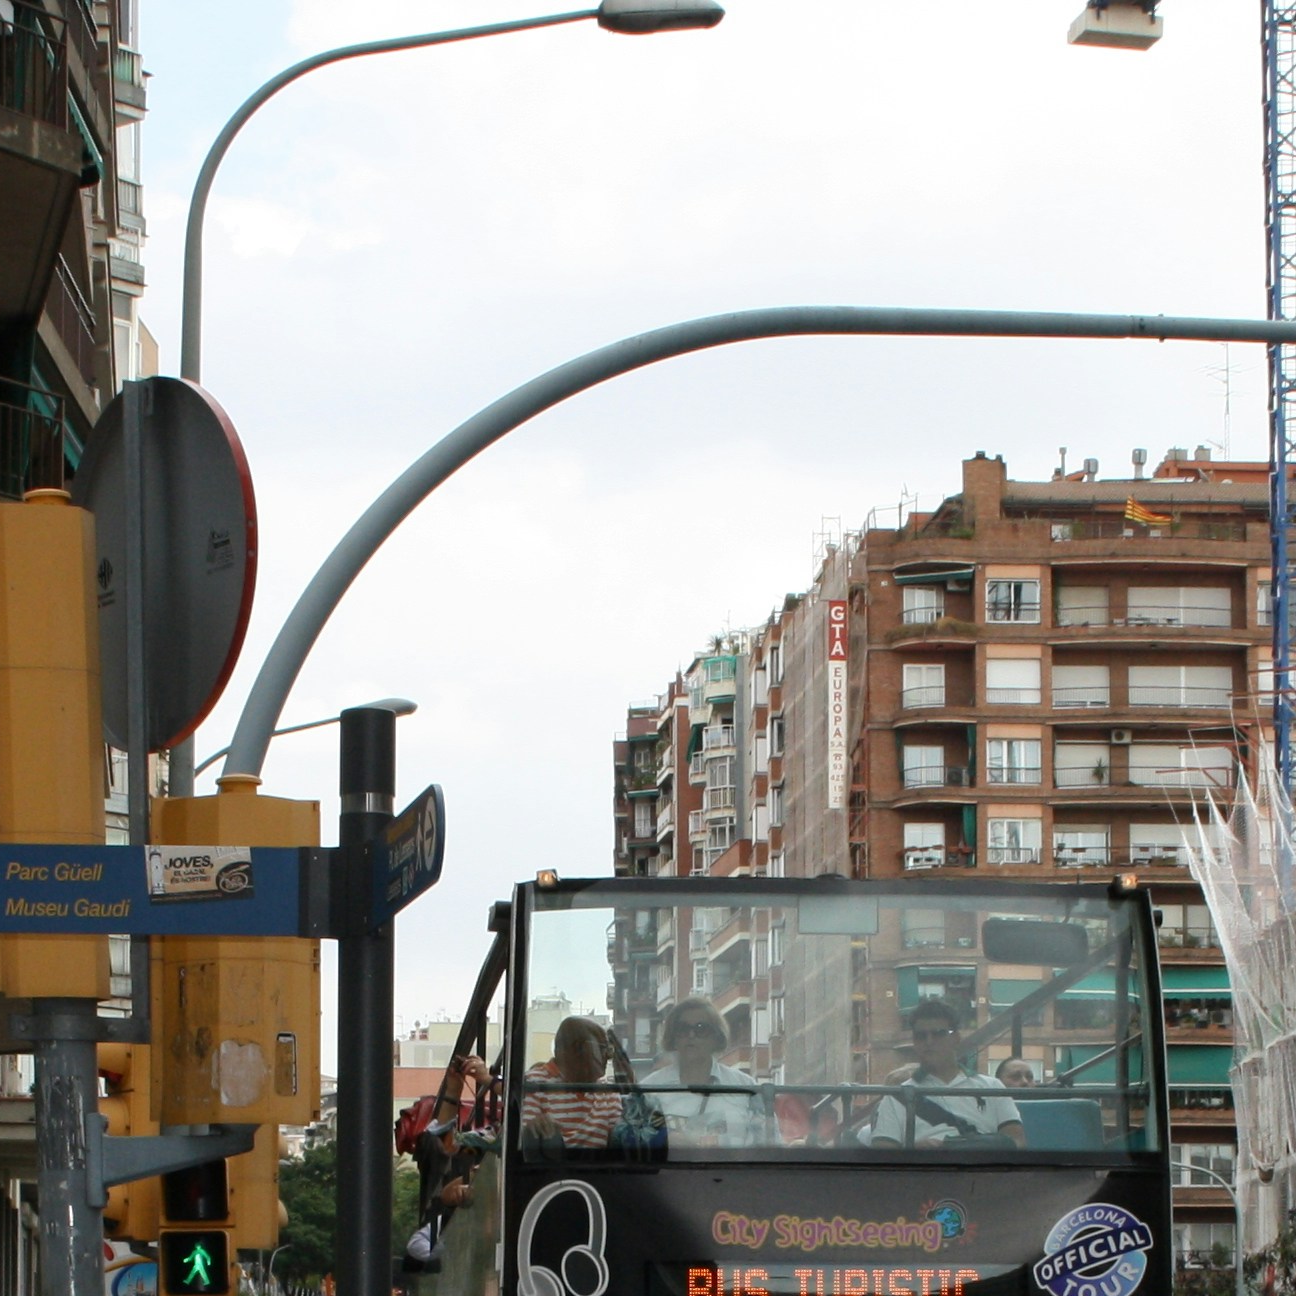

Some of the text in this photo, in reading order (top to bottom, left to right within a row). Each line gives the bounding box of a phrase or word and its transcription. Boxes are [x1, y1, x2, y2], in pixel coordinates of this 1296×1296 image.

[830, 605, 845, 656] GTA
[832, 667, 843, 738] EUROPA
[6, 862, 104, 882] Parc Güell
[164, 855, 214, 870] JOVES,
[6, 899, 68, 917] Museu
[712, 1210, 944, 1252] City Sightseeing
[1052, 1208, 1126, 1250] BARCELONA
[1040, 1229, 1146, 1281] OFFICIAL
